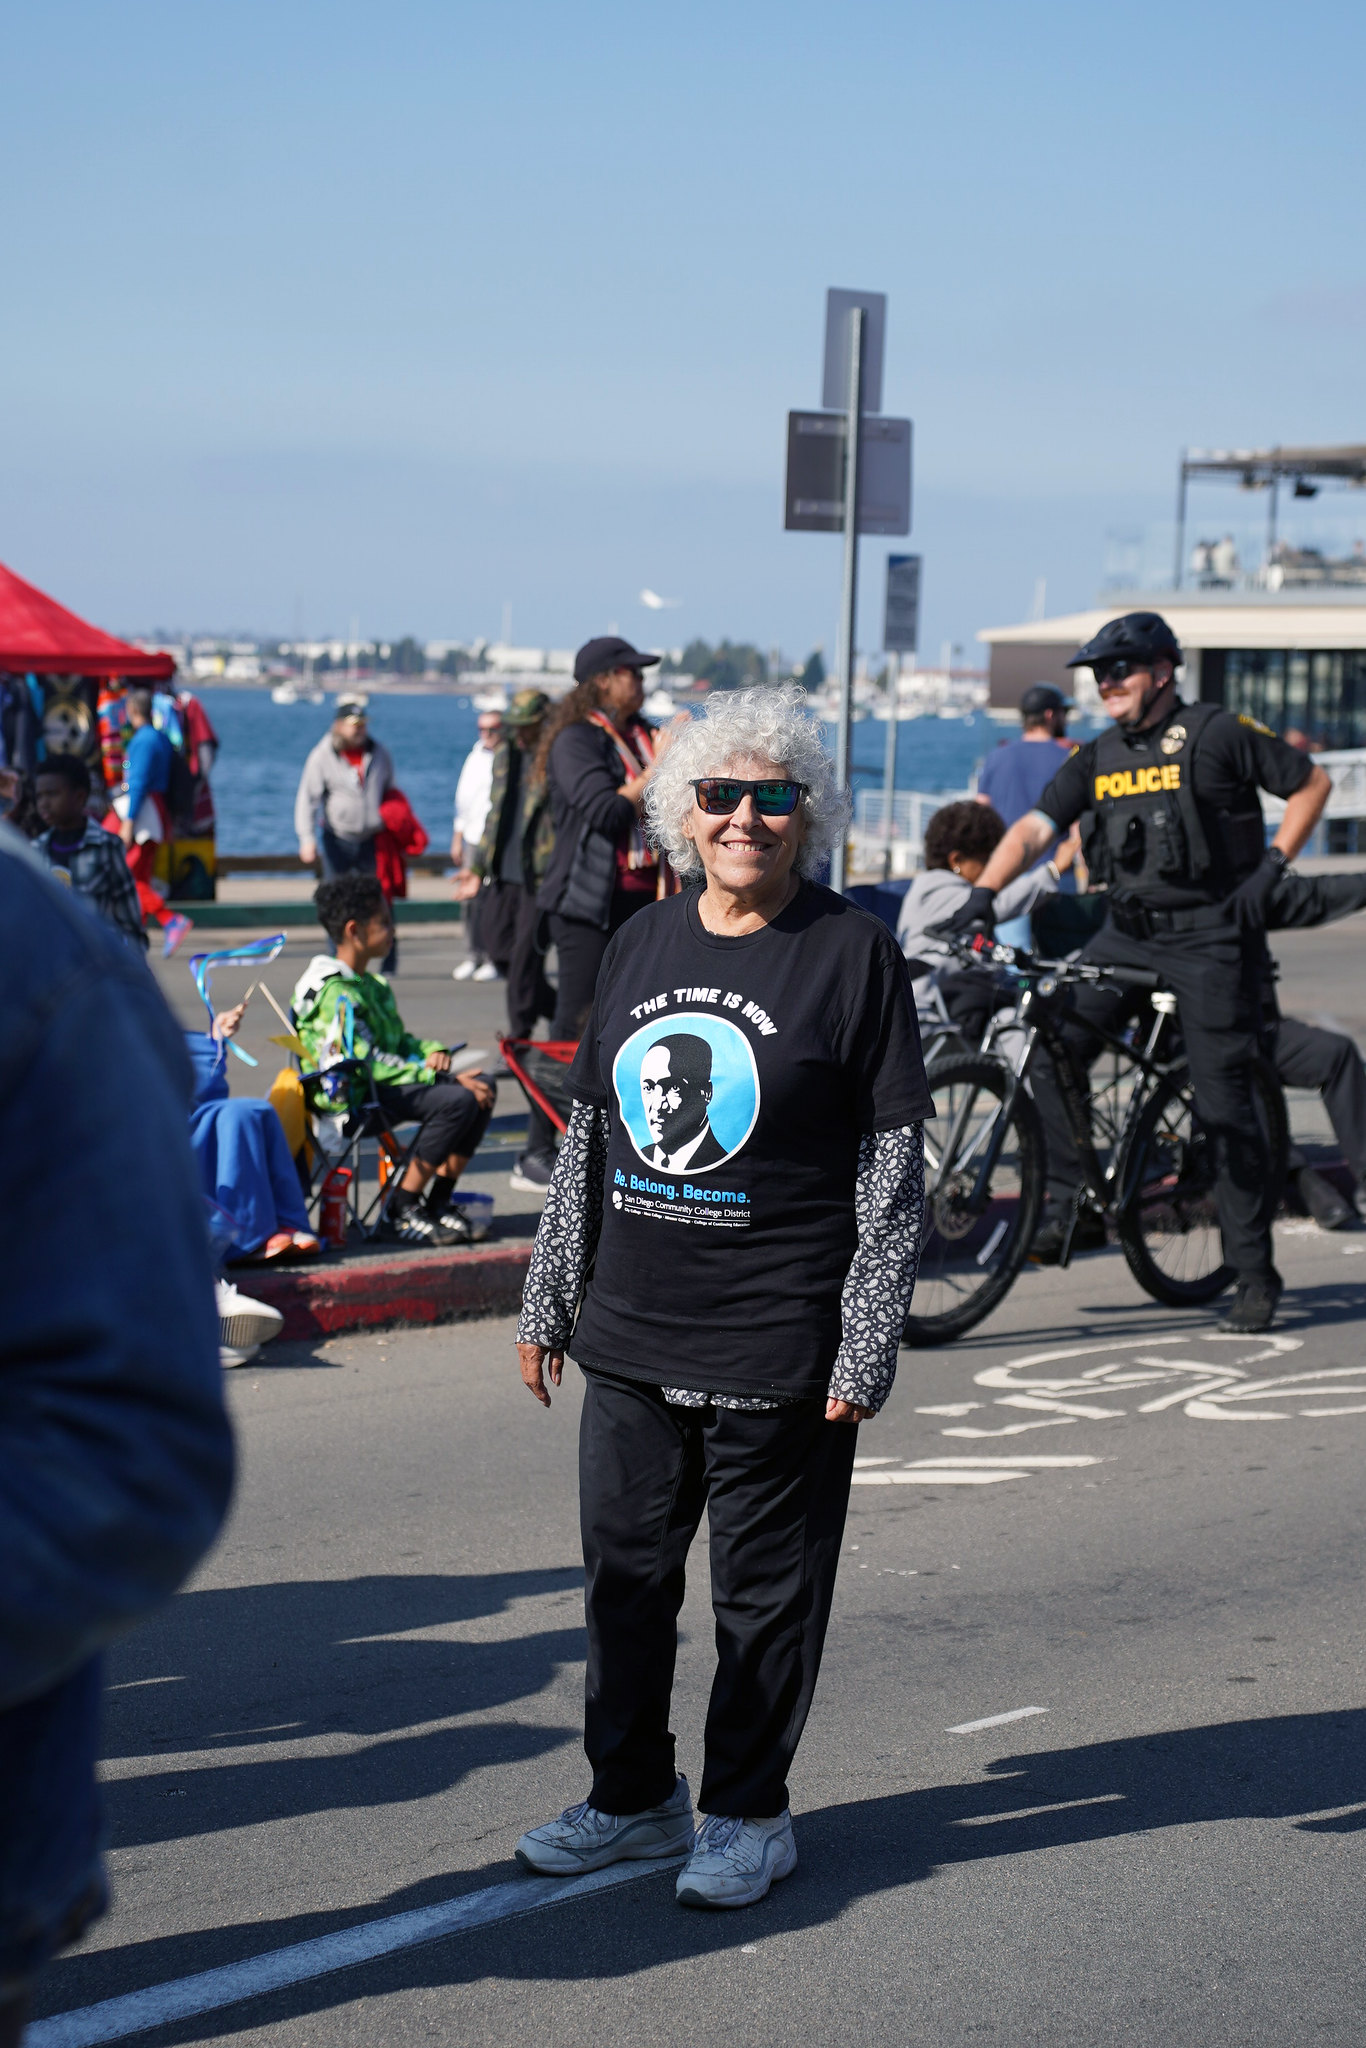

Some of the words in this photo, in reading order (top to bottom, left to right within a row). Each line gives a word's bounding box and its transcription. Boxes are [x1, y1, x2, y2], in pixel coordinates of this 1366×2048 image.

[1095, 764, 1181, 800] POLICE
[629, 992, 668, 1020] THE
[673, 988, 722, 1003] TIME
[722, 991, 743, 1009] IS
[741, 1000, 778, 1037] NOW
[614, 1168, 628, 1188] Be.
[630, 1174, 680, 1200] Belong.
[683, 1183, 751, 1204] Become.
[624, 1194, 636, 1204] San
[636, 1197, 655, 1209] Diego
[655, 1199, 694, 1216] Community
[694, 1206, 723, 1219] College
[723, 1209, 751, 1219] District
